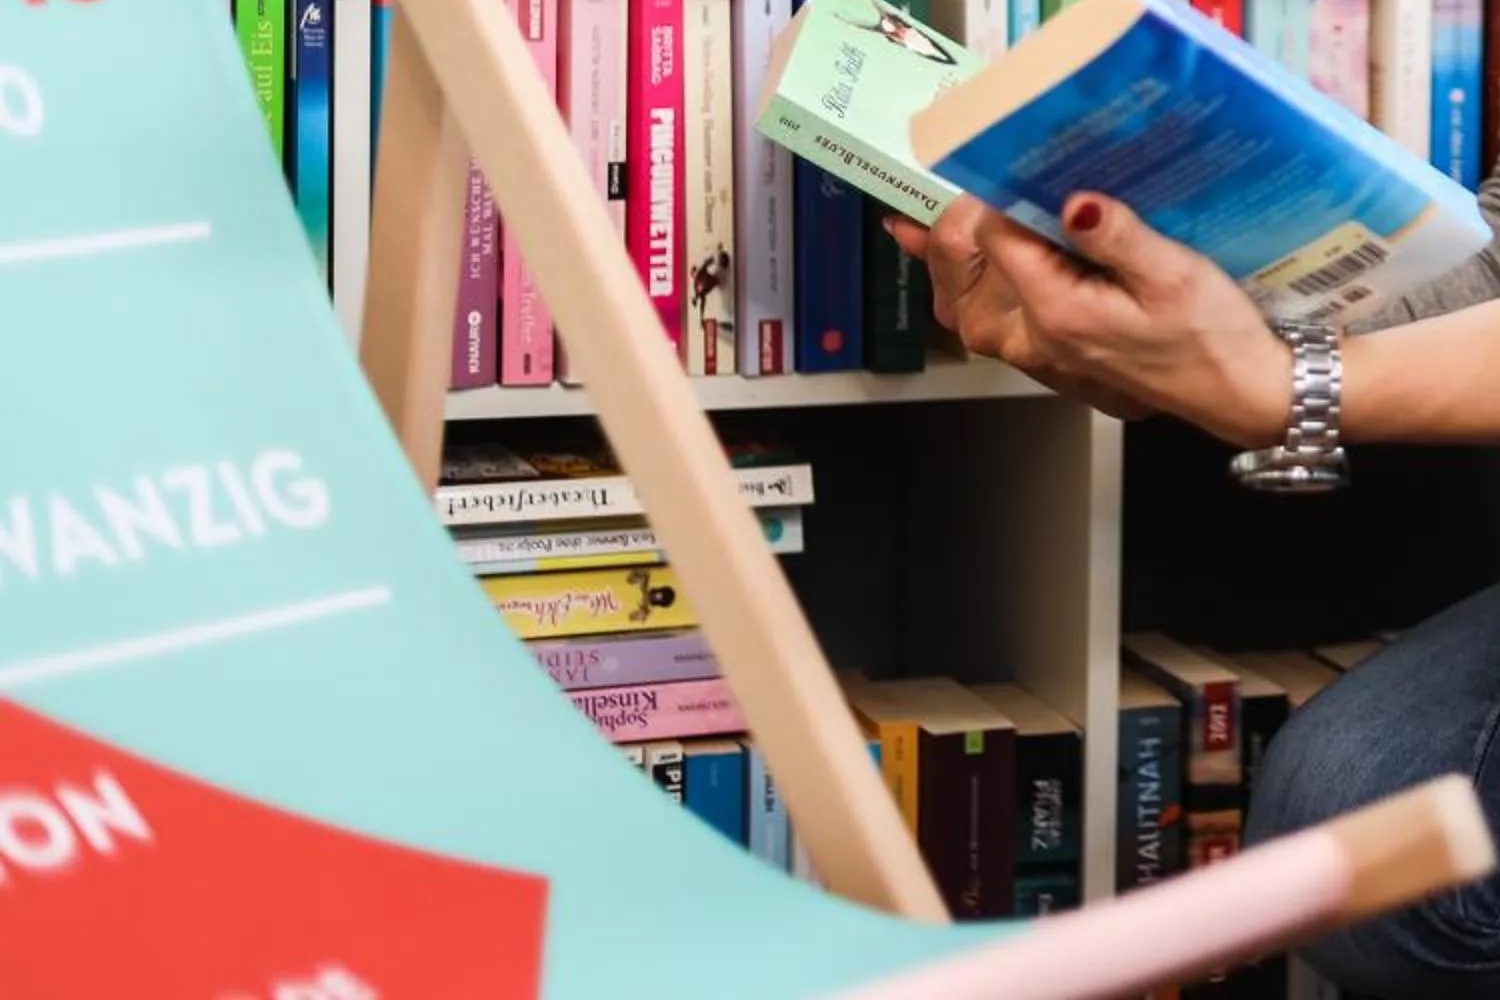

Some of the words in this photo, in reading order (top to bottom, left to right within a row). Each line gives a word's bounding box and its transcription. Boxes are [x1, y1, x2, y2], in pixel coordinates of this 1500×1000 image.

[250, 18, 274, 57] Eis
[468, 176, 482, 248] WÜNSCHE
[649, 106, 675, 298] PINGUINWETTER
[481, 223, 494, 255] MAL
[470, 252, 482, 280] ICH
[468, 326, 482, 374] KNAUR
[1136, 737, 1162, 884] HAUTNAH
